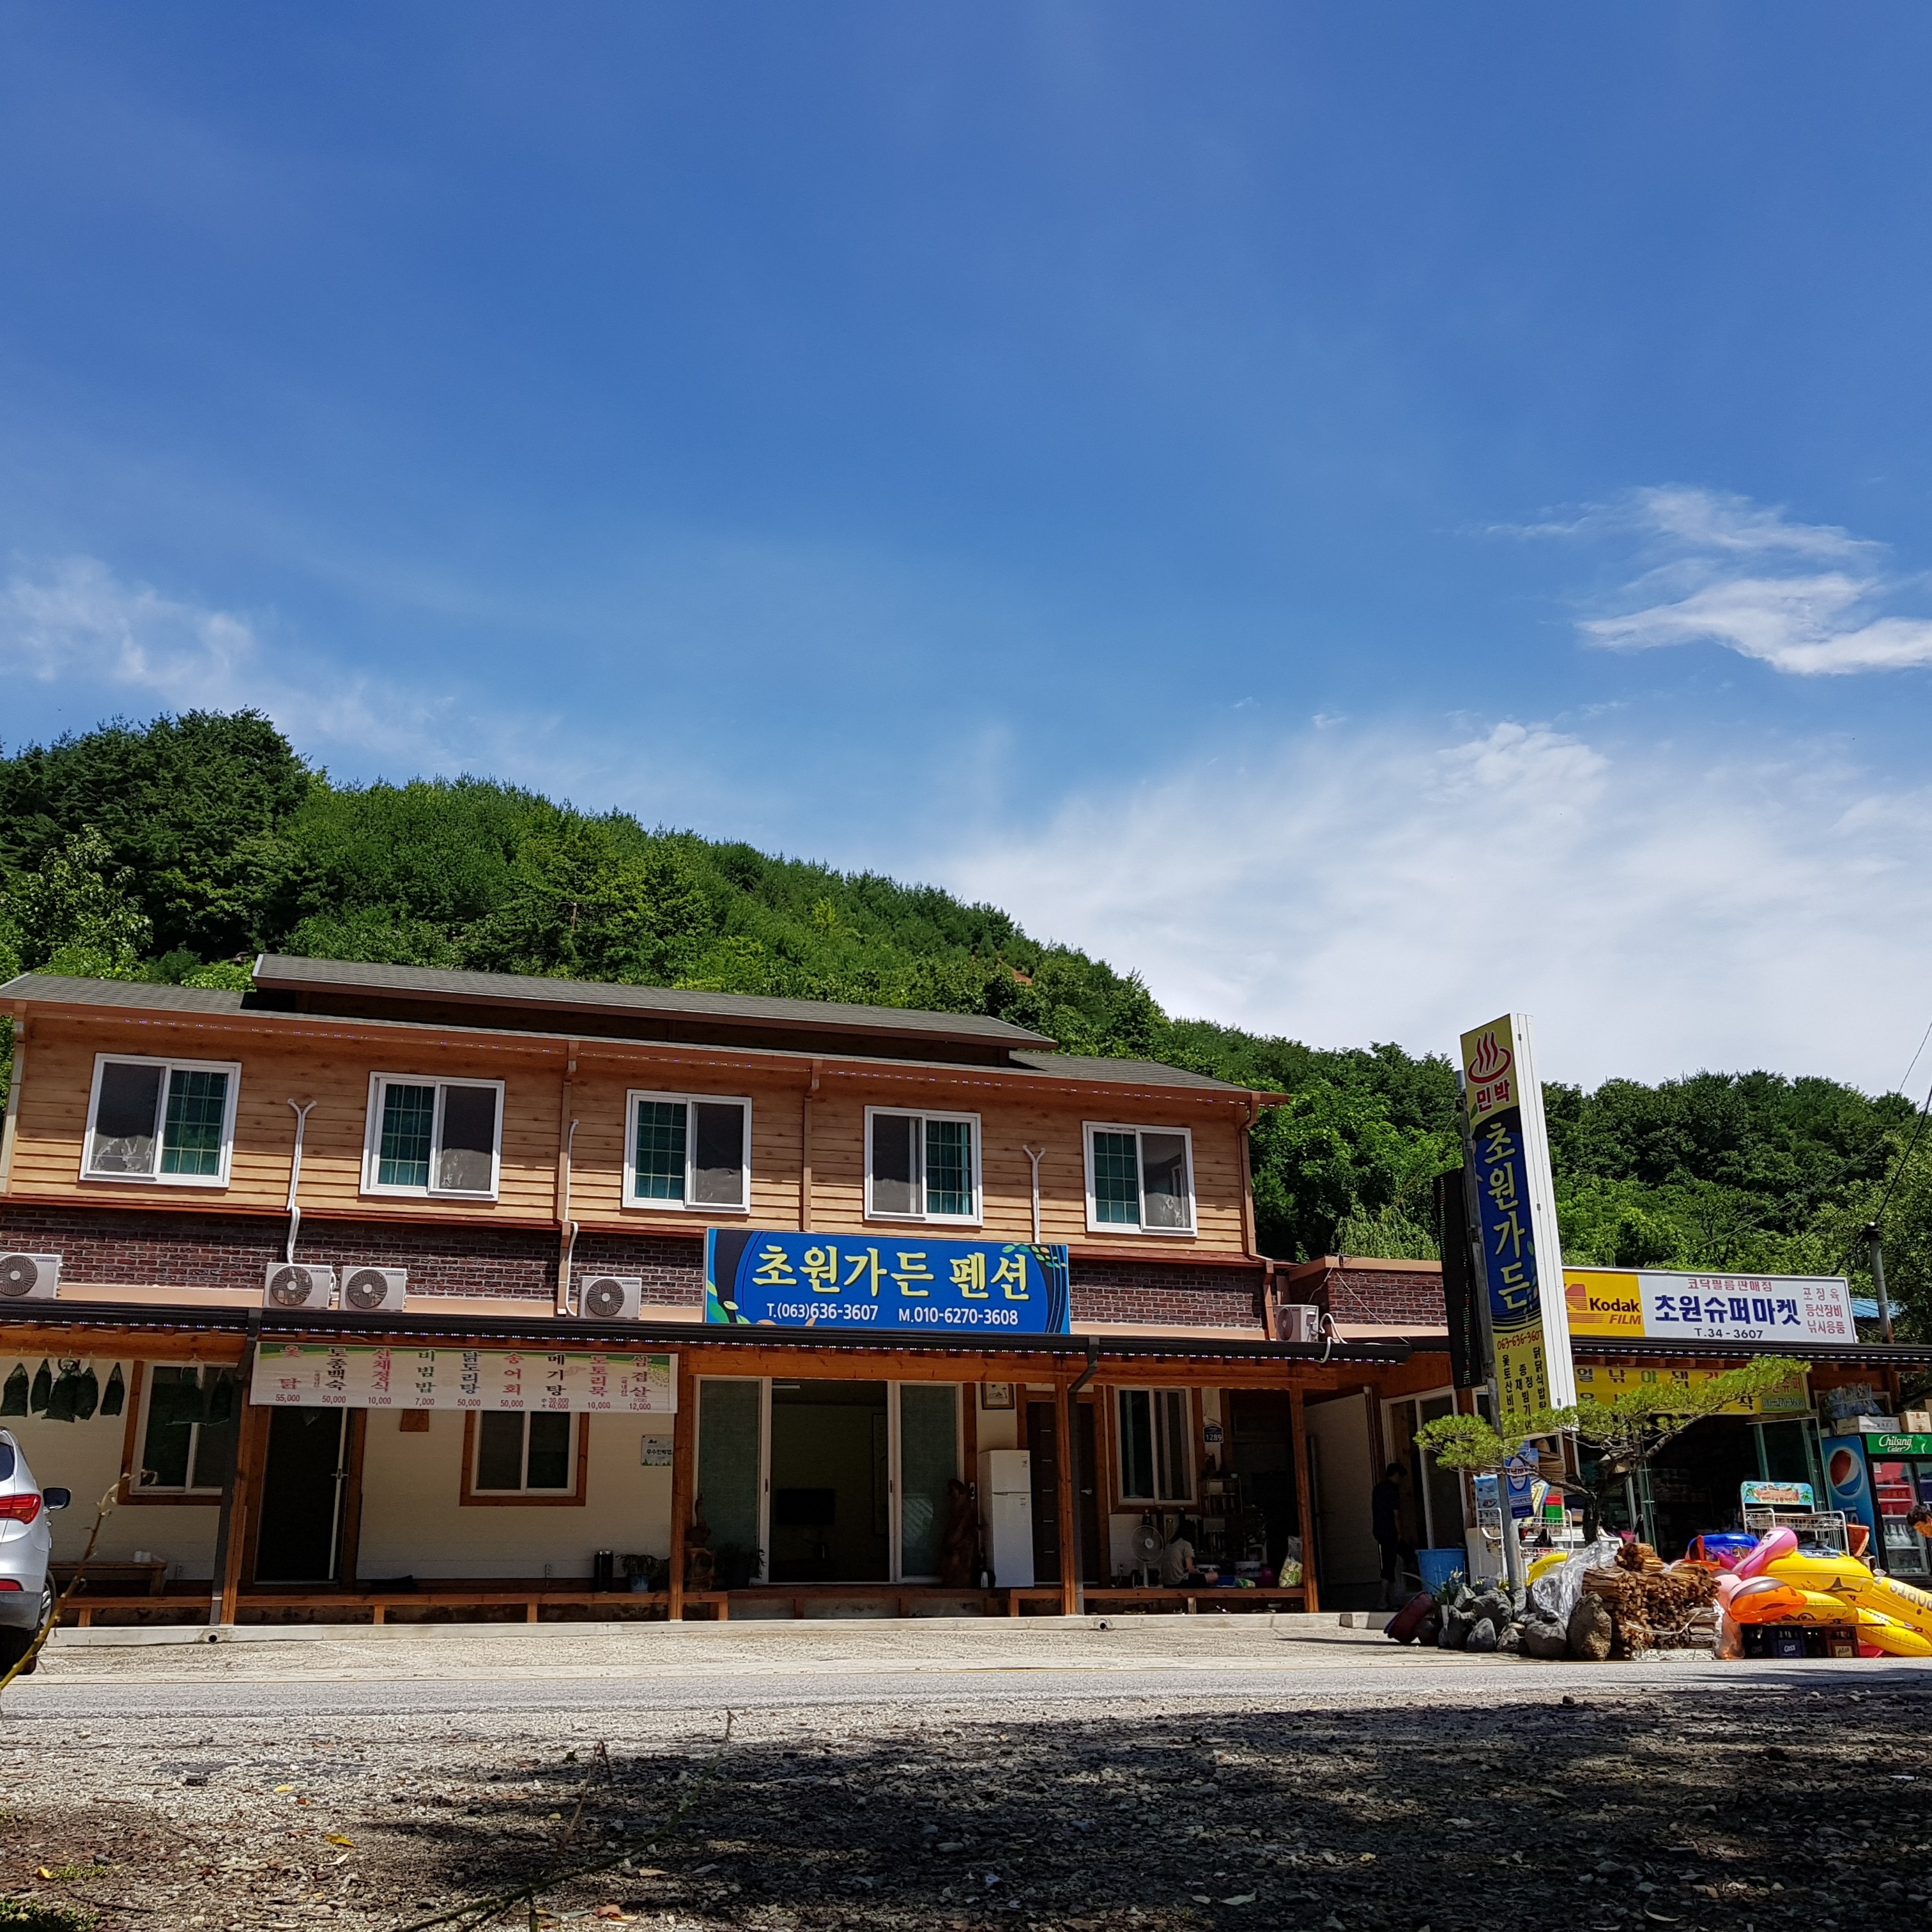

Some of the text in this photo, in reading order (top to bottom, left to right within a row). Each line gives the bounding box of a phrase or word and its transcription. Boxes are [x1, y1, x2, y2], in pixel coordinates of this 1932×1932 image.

[1476, 1080, 1511, 1112] 민박
[1485, 1122, 1530, 1309] 초원가든
[752, 1245, 1029, 1301] 초원가든 펜션
[767, 1302, 878, 1321] T.(063)636-3607
[899, 1307, 1018, 1325] M.010-6270-3608
[1589, 1298, 1641, 1313] Kodak
[1655, 1295, 1801, 1326] 초원슈퍼마켓
[1609, 1314, 1641, 1325] FILM
[1497, 1330, 1543, 1350] 063-636-3607
[325, 1348, 348, 1391] 토종백숙
[371, 1349, 394, 1392] 산채정식
[415, 1351, 436, 1393] 비빔밥
[460, 1351, 481, 1394] 닭도리탕
[502, 1353, 525, 1395] 송어회
[546, 1354, 567, 1396] 메기탕
[588, 1356, 610, 1397] 도토리묵
[630, 1356, 652, 1397] 삼겹살
[275, 1394, 300, 1404] 55,000
[322, 1395, 346, 1404] 50,000
[368, 1397, 392, 1406] 10,000
[415, 1398, 435, 1406] 7,000
[457, 1399, 481, 1407] 50,000
[500, 1399, 524, 1409] 50,000
[588, 1402, 611, 1411] 10,000
